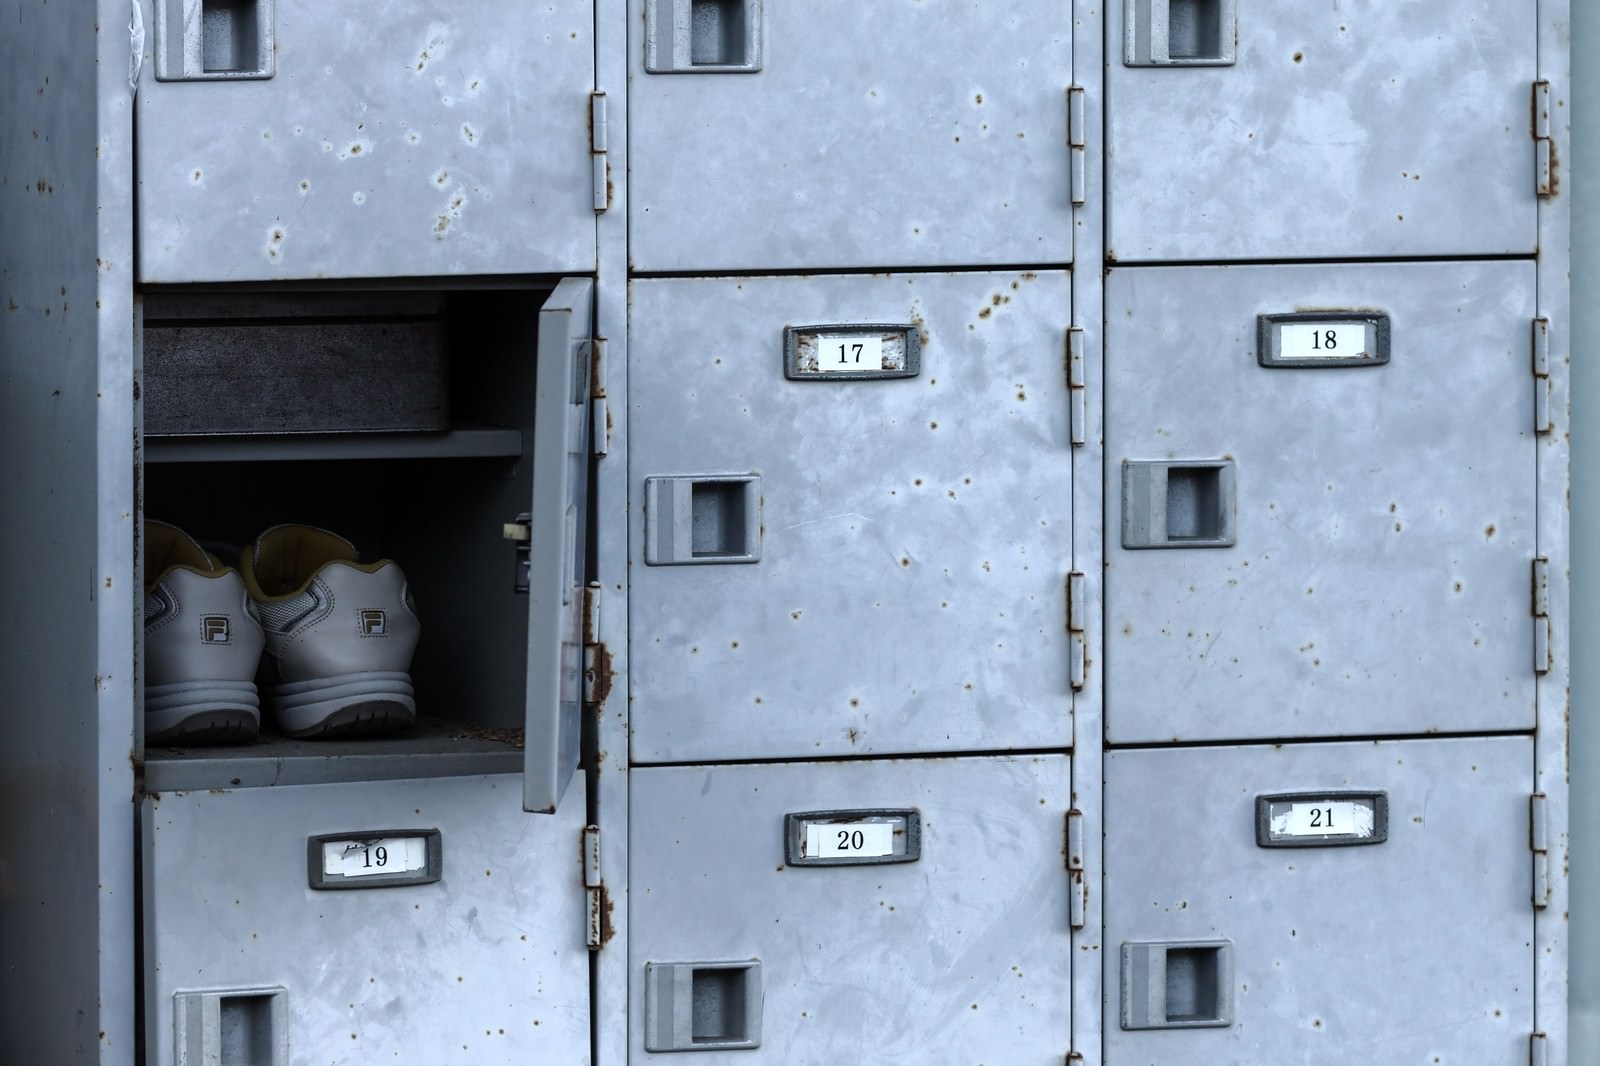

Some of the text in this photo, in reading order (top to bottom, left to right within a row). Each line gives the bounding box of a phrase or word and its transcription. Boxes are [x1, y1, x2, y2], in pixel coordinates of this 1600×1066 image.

[1311, 330, 1337, 350] 18
[838, 343, 865, 365] 17
[1310, 808, 1334, 828] 21
[837, 830, 864, 850] 20
[362, 846, 388, 868] 19
